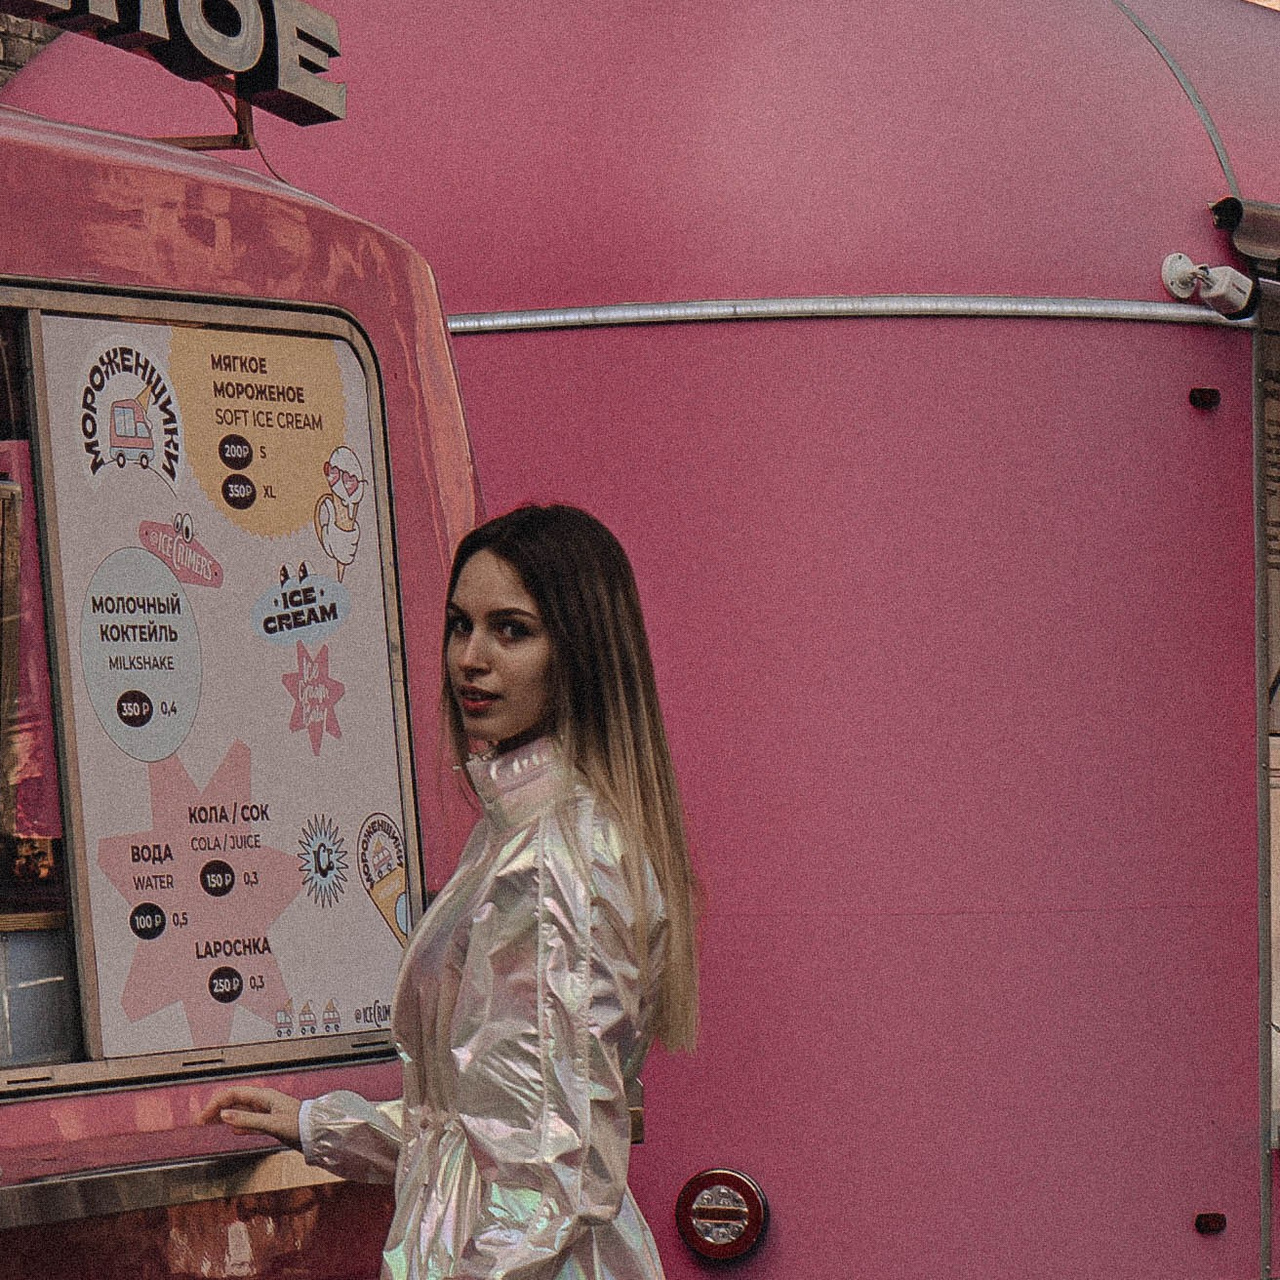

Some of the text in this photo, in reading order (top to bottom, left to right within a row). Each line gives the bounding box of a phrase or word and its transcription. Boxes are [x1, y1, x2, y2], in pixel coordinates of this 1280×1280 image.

[210, 353, 268, 375] МЯГКОЕ
[212, 380, 305, 405] МОРОЖЕНОЕ
[81, 347, 181, 482] МОРОЖЕНЩИКИ
[215, 409, 323, 431] SOFT ICE CREAM
[260, 446, 267, 459] S
[262, 485, 277, 500] XL
[91, 592, 181, 615] МОЛОЧНЫЙ
[281, 586, 317, 608] ICE
[262, 603, 338, 634] CREAM
[99, 621, 179, 643] КОКТЕЙЛЬ
[108, 655, 175, 671] MILKSHAKE
[160, 701, 178, 717] 0,4
[188, 805, 229, 824] КОЛА
[240, 803, 270, 821] СОК
[130, 844, 174, 863] ВОДА
[190, 836, 222, 851] COLA
[230, 834, 261, 850] JUICE
[313, 842, 334, 878] ICE
[361, 820, 404, 890] МОРОЖЕНЩИКИ
[133, 874, 175, 890] WATER
[243, 872, 259, 887] 0,3
[172, 913, 188, 928] 0,5
[195, 936, 271, 959] LAPOCHKA
[250, 975, 265, 990] 0,3
[355, 1000, 391, 1028] @ICECRIM
